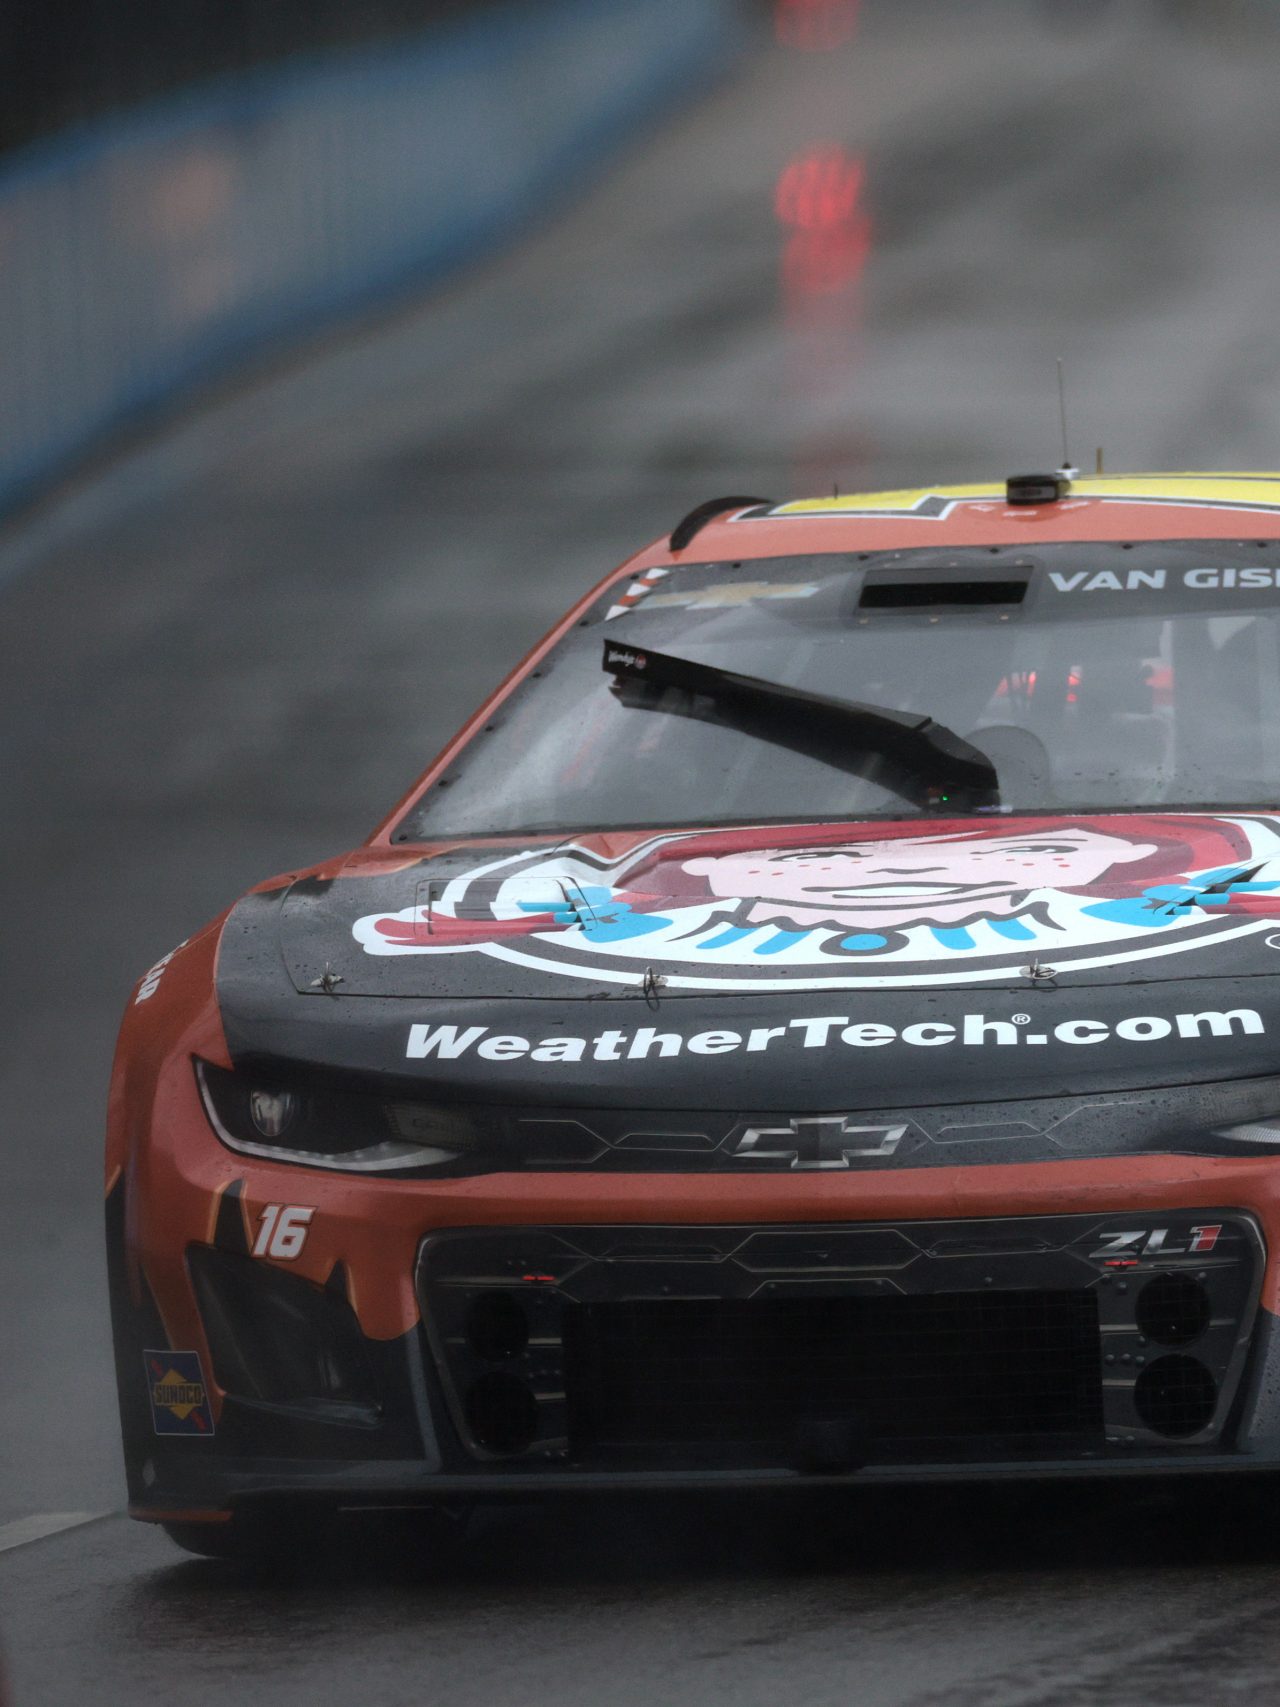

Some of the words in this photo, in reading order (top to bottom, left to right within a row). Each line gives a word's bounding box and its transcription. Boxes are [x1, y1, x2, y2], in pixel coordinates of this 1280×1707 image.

[1049, 569, 1166, 592] VAN
[253, 1205, 317, 1259] 16
[1088, 1223, 1223, 1259] ZL1
[153, 1383, 203, 1406] SUNOCO
